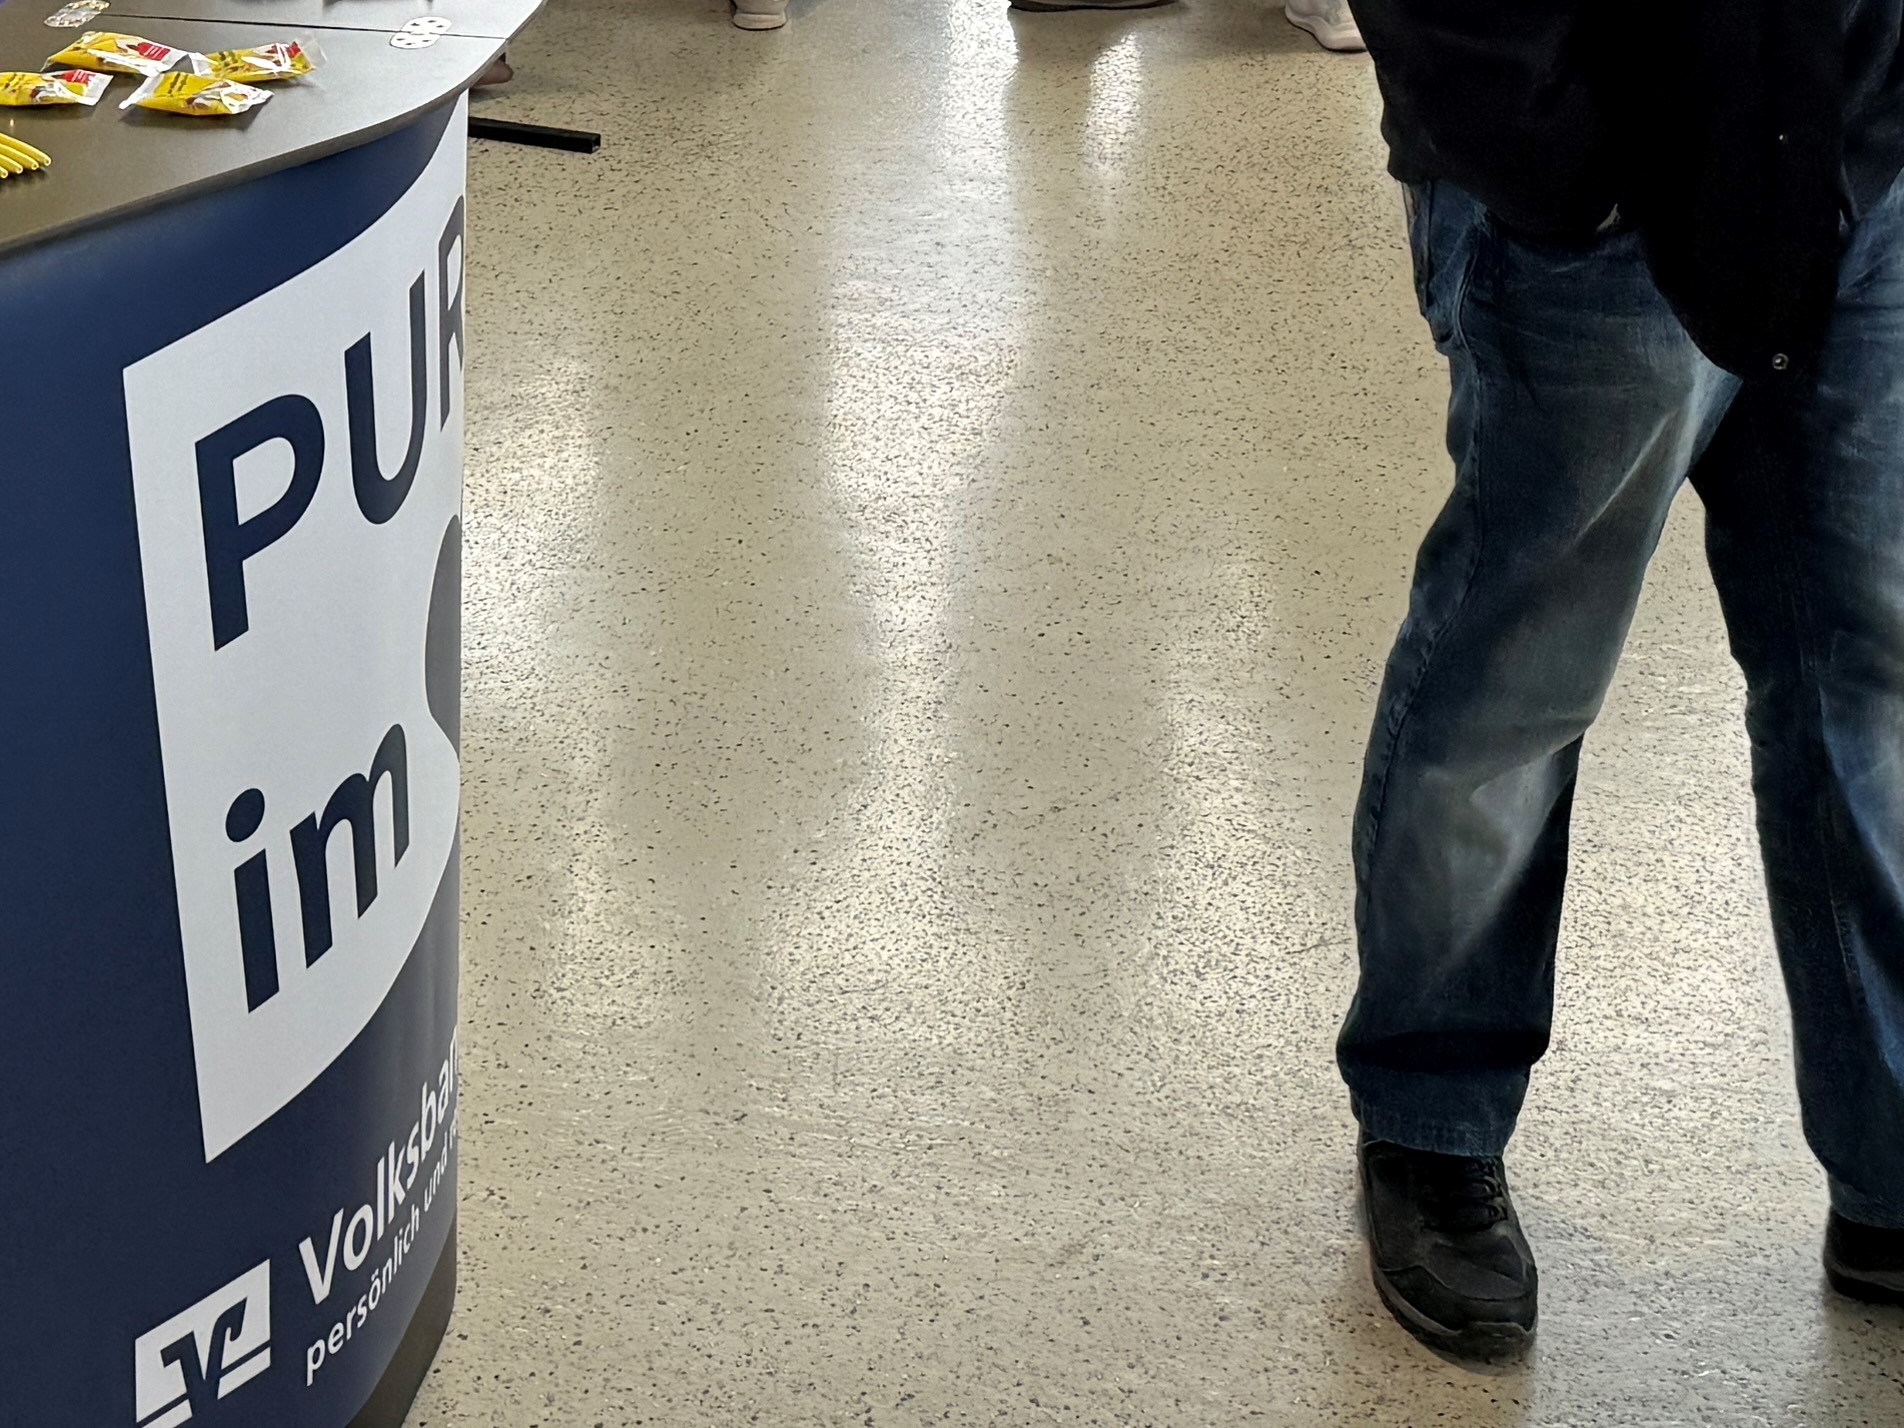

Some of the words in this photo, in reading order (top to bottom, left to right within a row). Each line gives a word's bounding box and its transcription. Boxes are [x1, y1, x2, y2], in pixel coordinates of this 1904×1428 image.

[194, 194, 464, 652] PUR
[225, 722, 410, 1013] im
[298, 1025, 457, 1305] Volksban
[306, 1203, 420, 1387] persönlich
